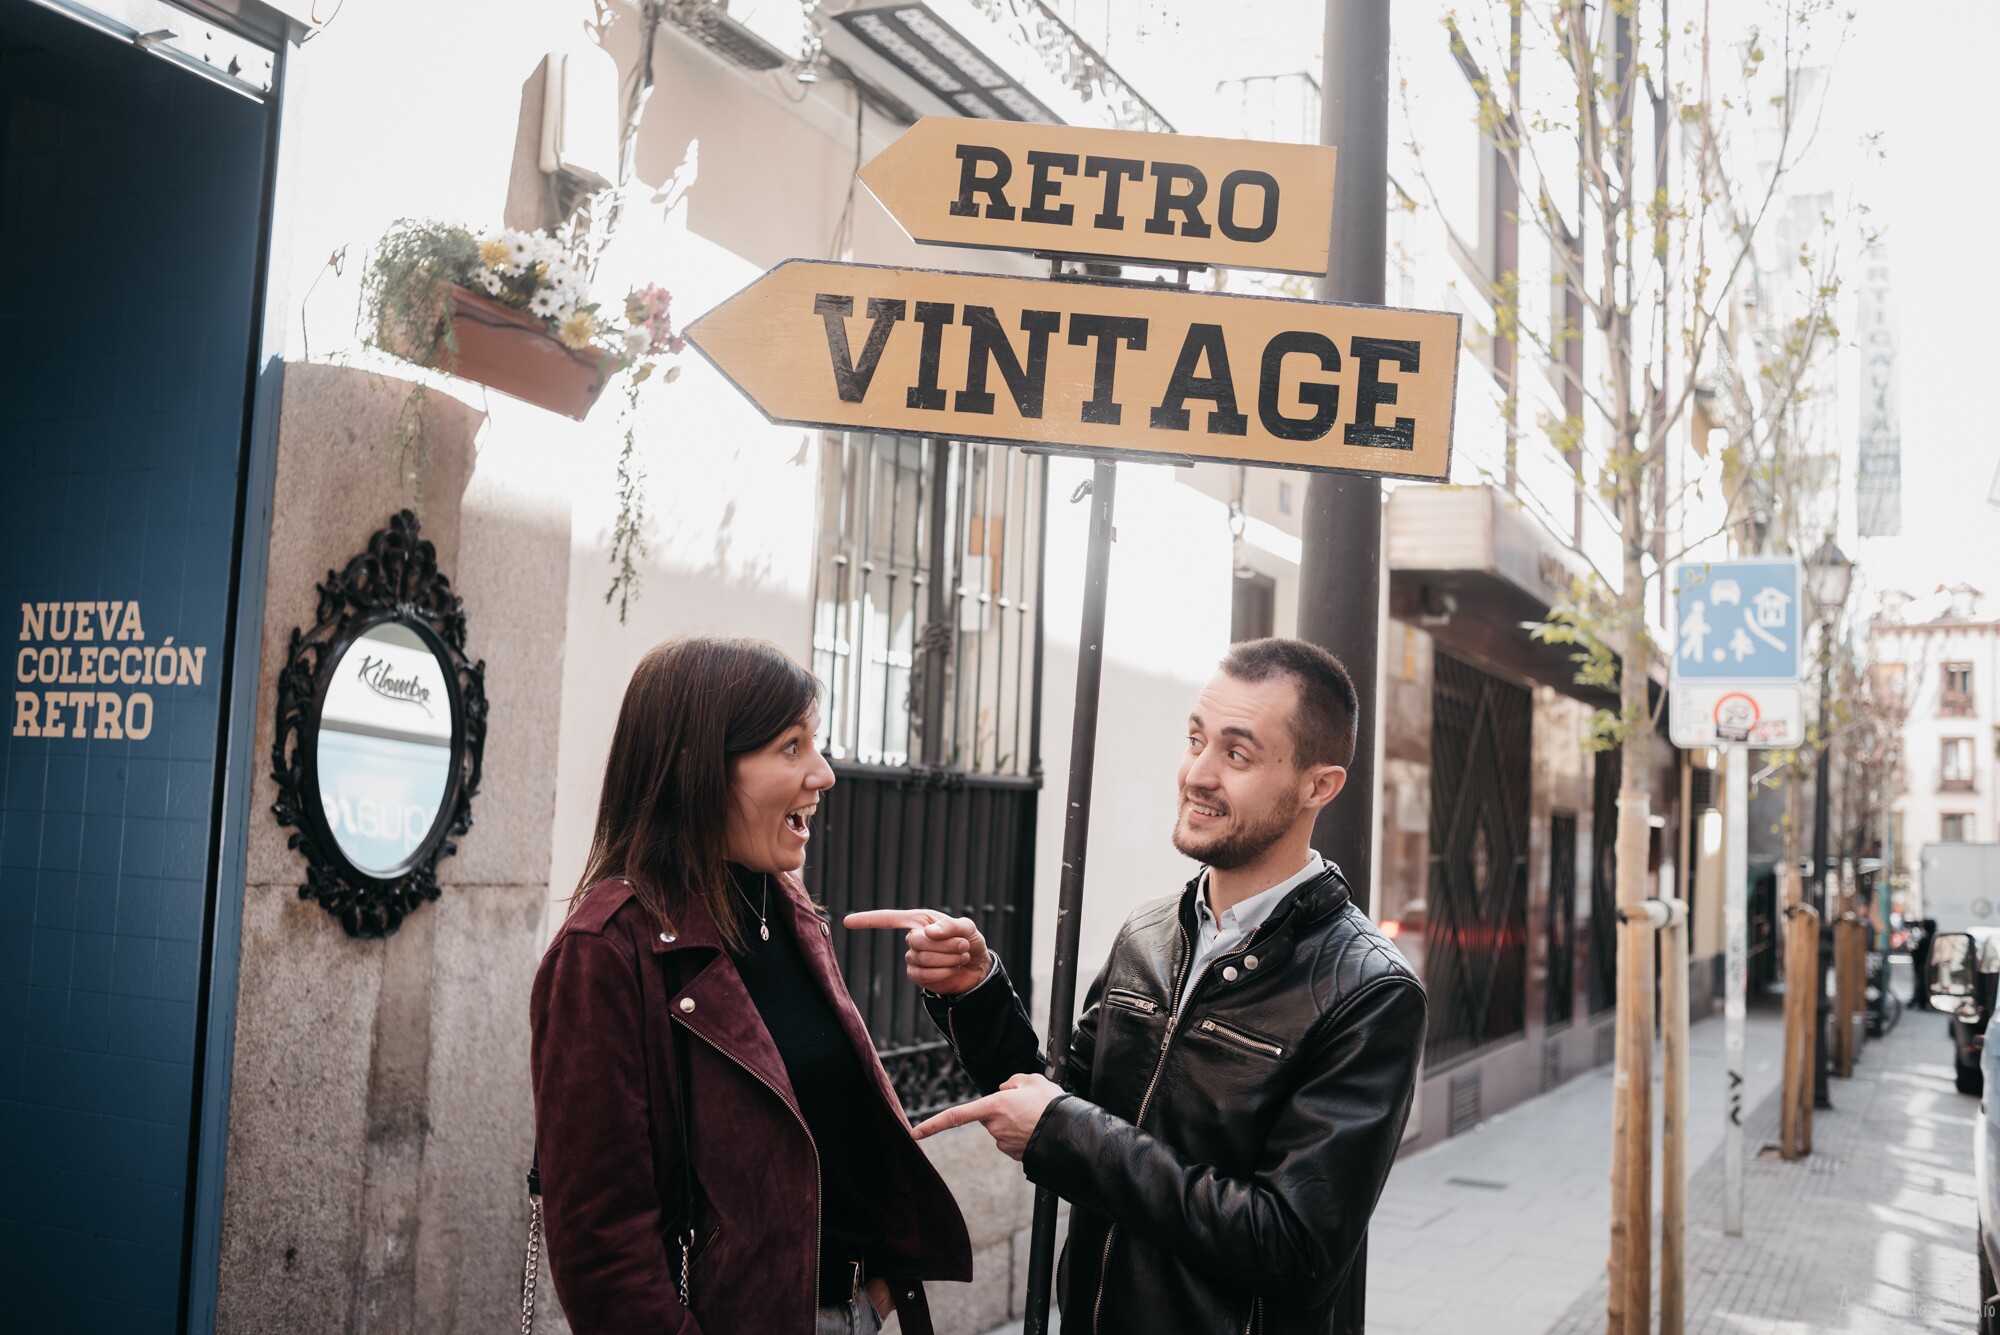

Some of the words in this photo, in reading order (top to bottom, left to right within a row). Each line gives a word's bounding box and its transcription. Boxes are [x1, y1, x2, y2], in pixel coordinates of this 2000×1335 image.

[949, 143, 1281, 243] RETRO
[813, 293, 1422, 451] VINTAGE
[19, 601, 145, 641] NUEVA
[17, 636, 206, 686] COLECCIÓN
[13, 692, 153, 740] RETRO
